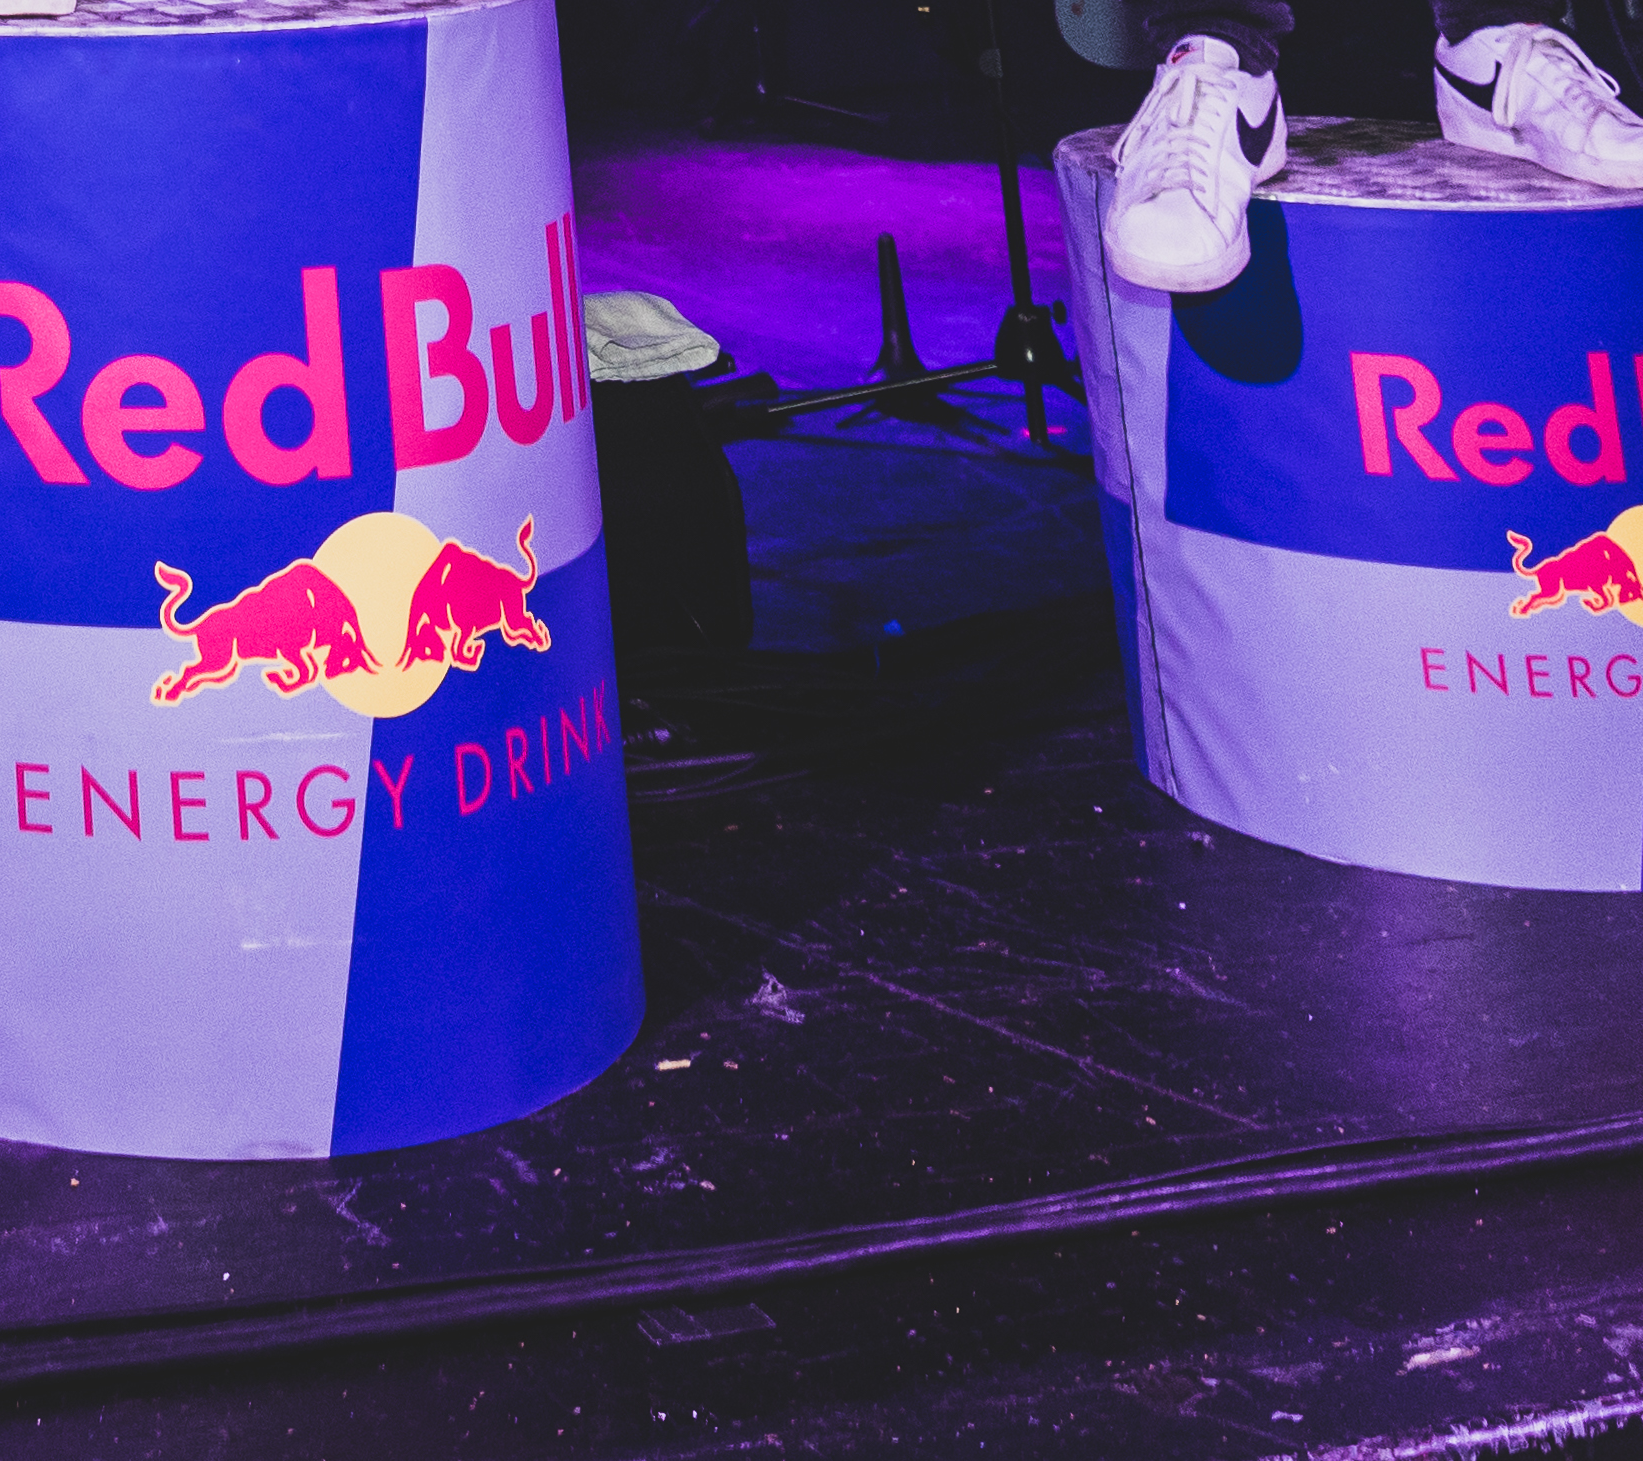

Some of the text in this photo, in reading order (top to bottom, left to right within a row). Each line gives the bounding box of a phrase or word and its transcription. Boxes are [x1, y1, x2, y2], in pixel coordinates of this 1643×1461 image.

[379, 212, 588, 472] Bull
[1349, 350, 1627, 487] Red
[14, 679, 612, 842] ENERGY DRINK
